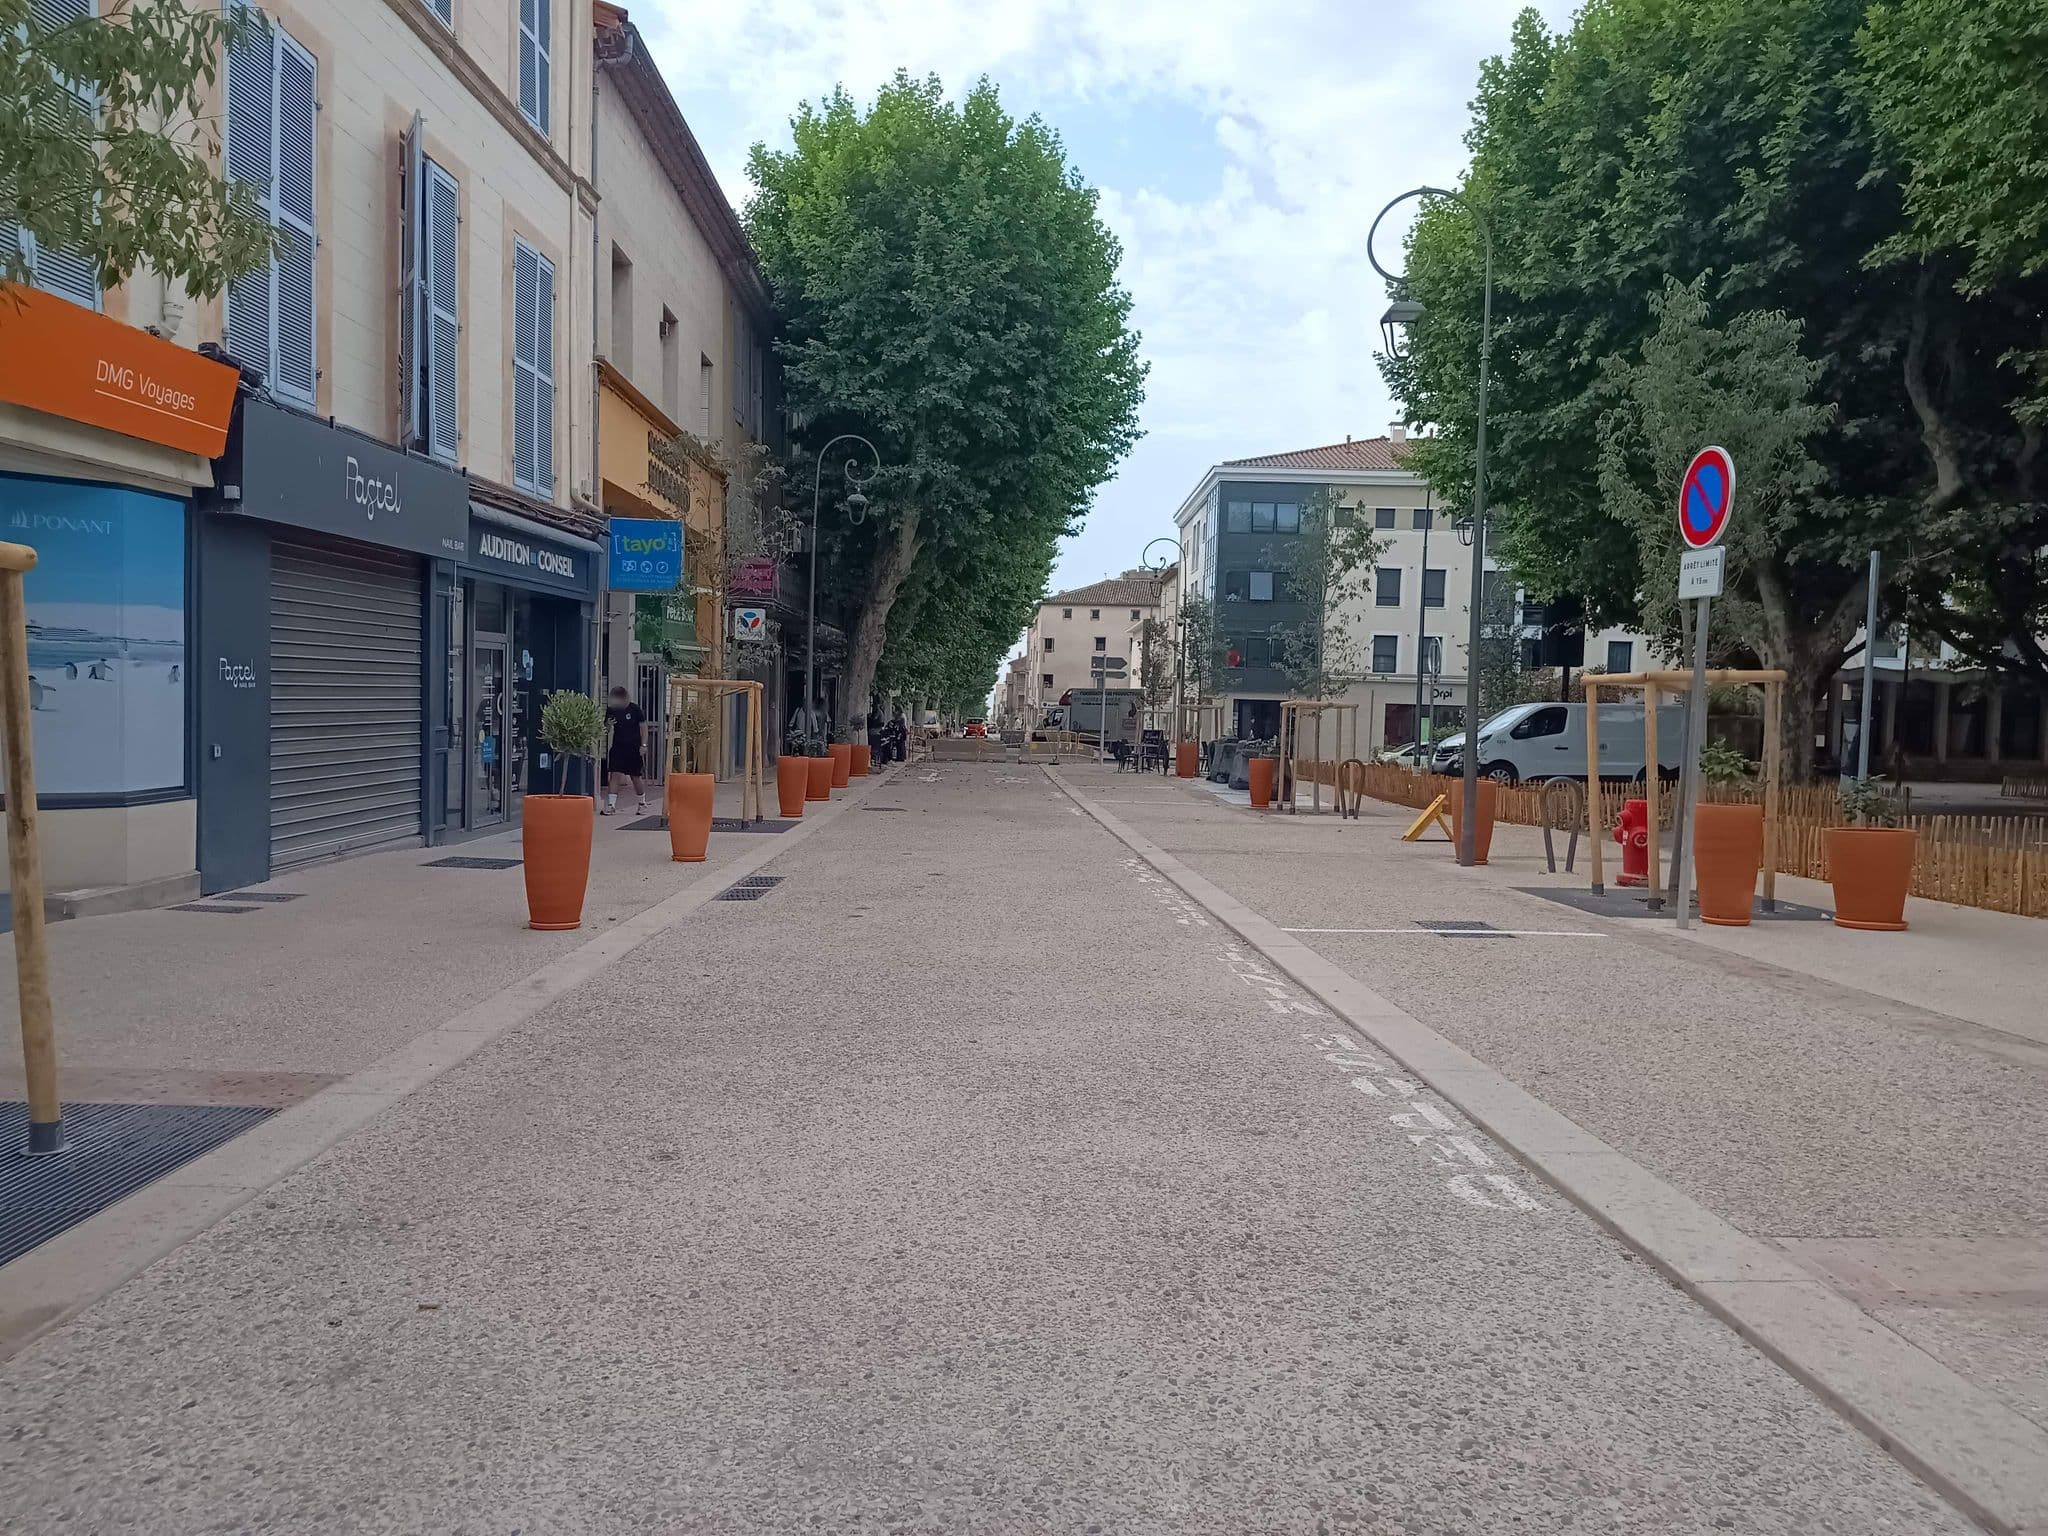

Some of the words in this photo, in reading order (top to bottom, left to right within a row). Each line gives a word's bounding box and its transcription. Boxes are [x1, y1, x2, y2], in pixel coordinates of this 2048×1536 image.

[96, 359, 134, 390] DMG
[139, 373, 196, 411] Voyages
[345, 455, 402, 521] Pastel
[33, 513, 113, 535] PONANT
[441, 537, 454, 549] NAIL
[454, 540, 465, 552] BAR
[479, 533, 530, 566] AUDITION
[537, 550, 575, 578] CONSEIL
[219, 657, 256, 688] Pastel
[1433, 688, 1452, 700] Orpi
